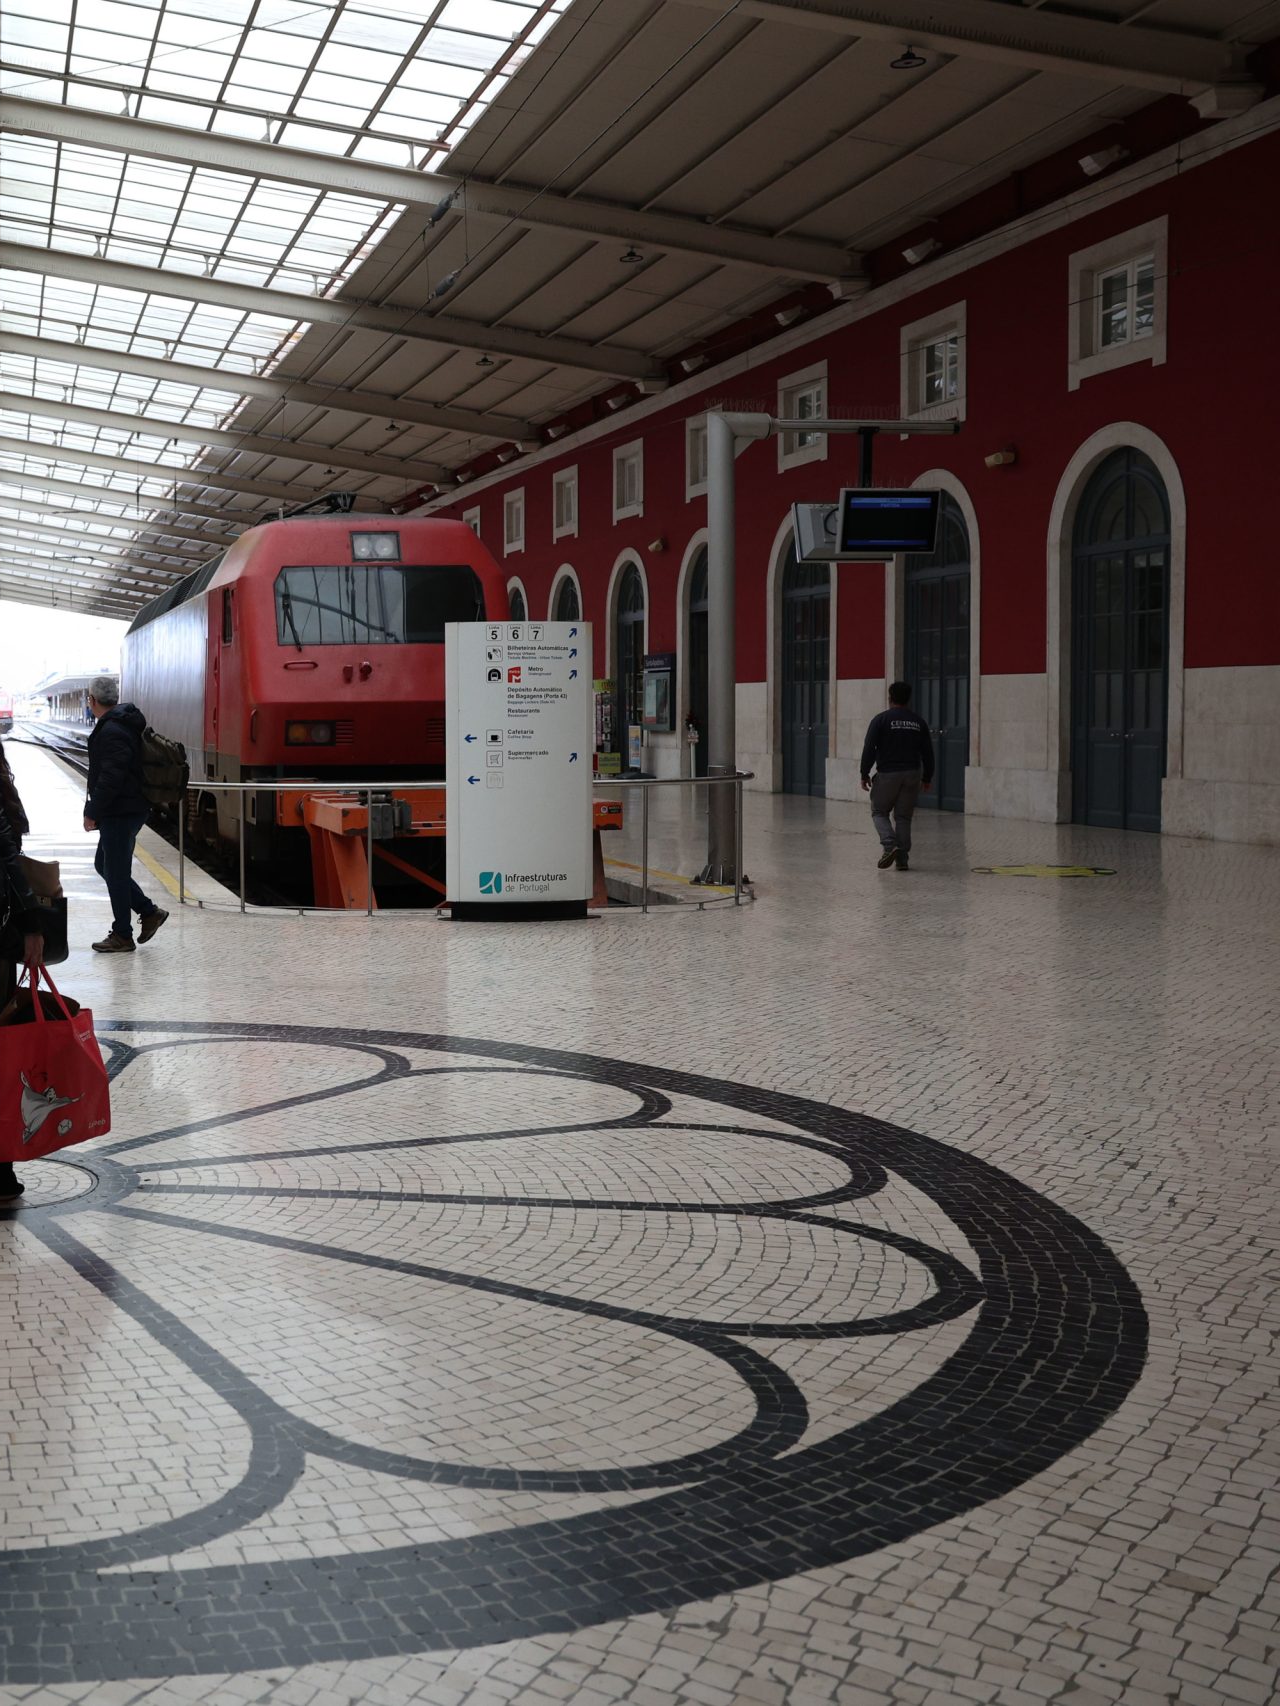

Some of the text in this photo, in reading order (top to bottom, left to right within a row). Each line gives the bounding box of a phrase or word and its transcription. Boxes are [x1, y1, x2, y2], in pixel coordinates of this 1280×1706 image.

[491, 630, 498, 640] 5
[512, 629, 519, 640] 6
[532, 630, 540, 640] 7
[516, 693, 543, 701] Bagagens
[505, 873, 569, 882] Infraestruturas
[505, 883, 550, 893] de Portugal
